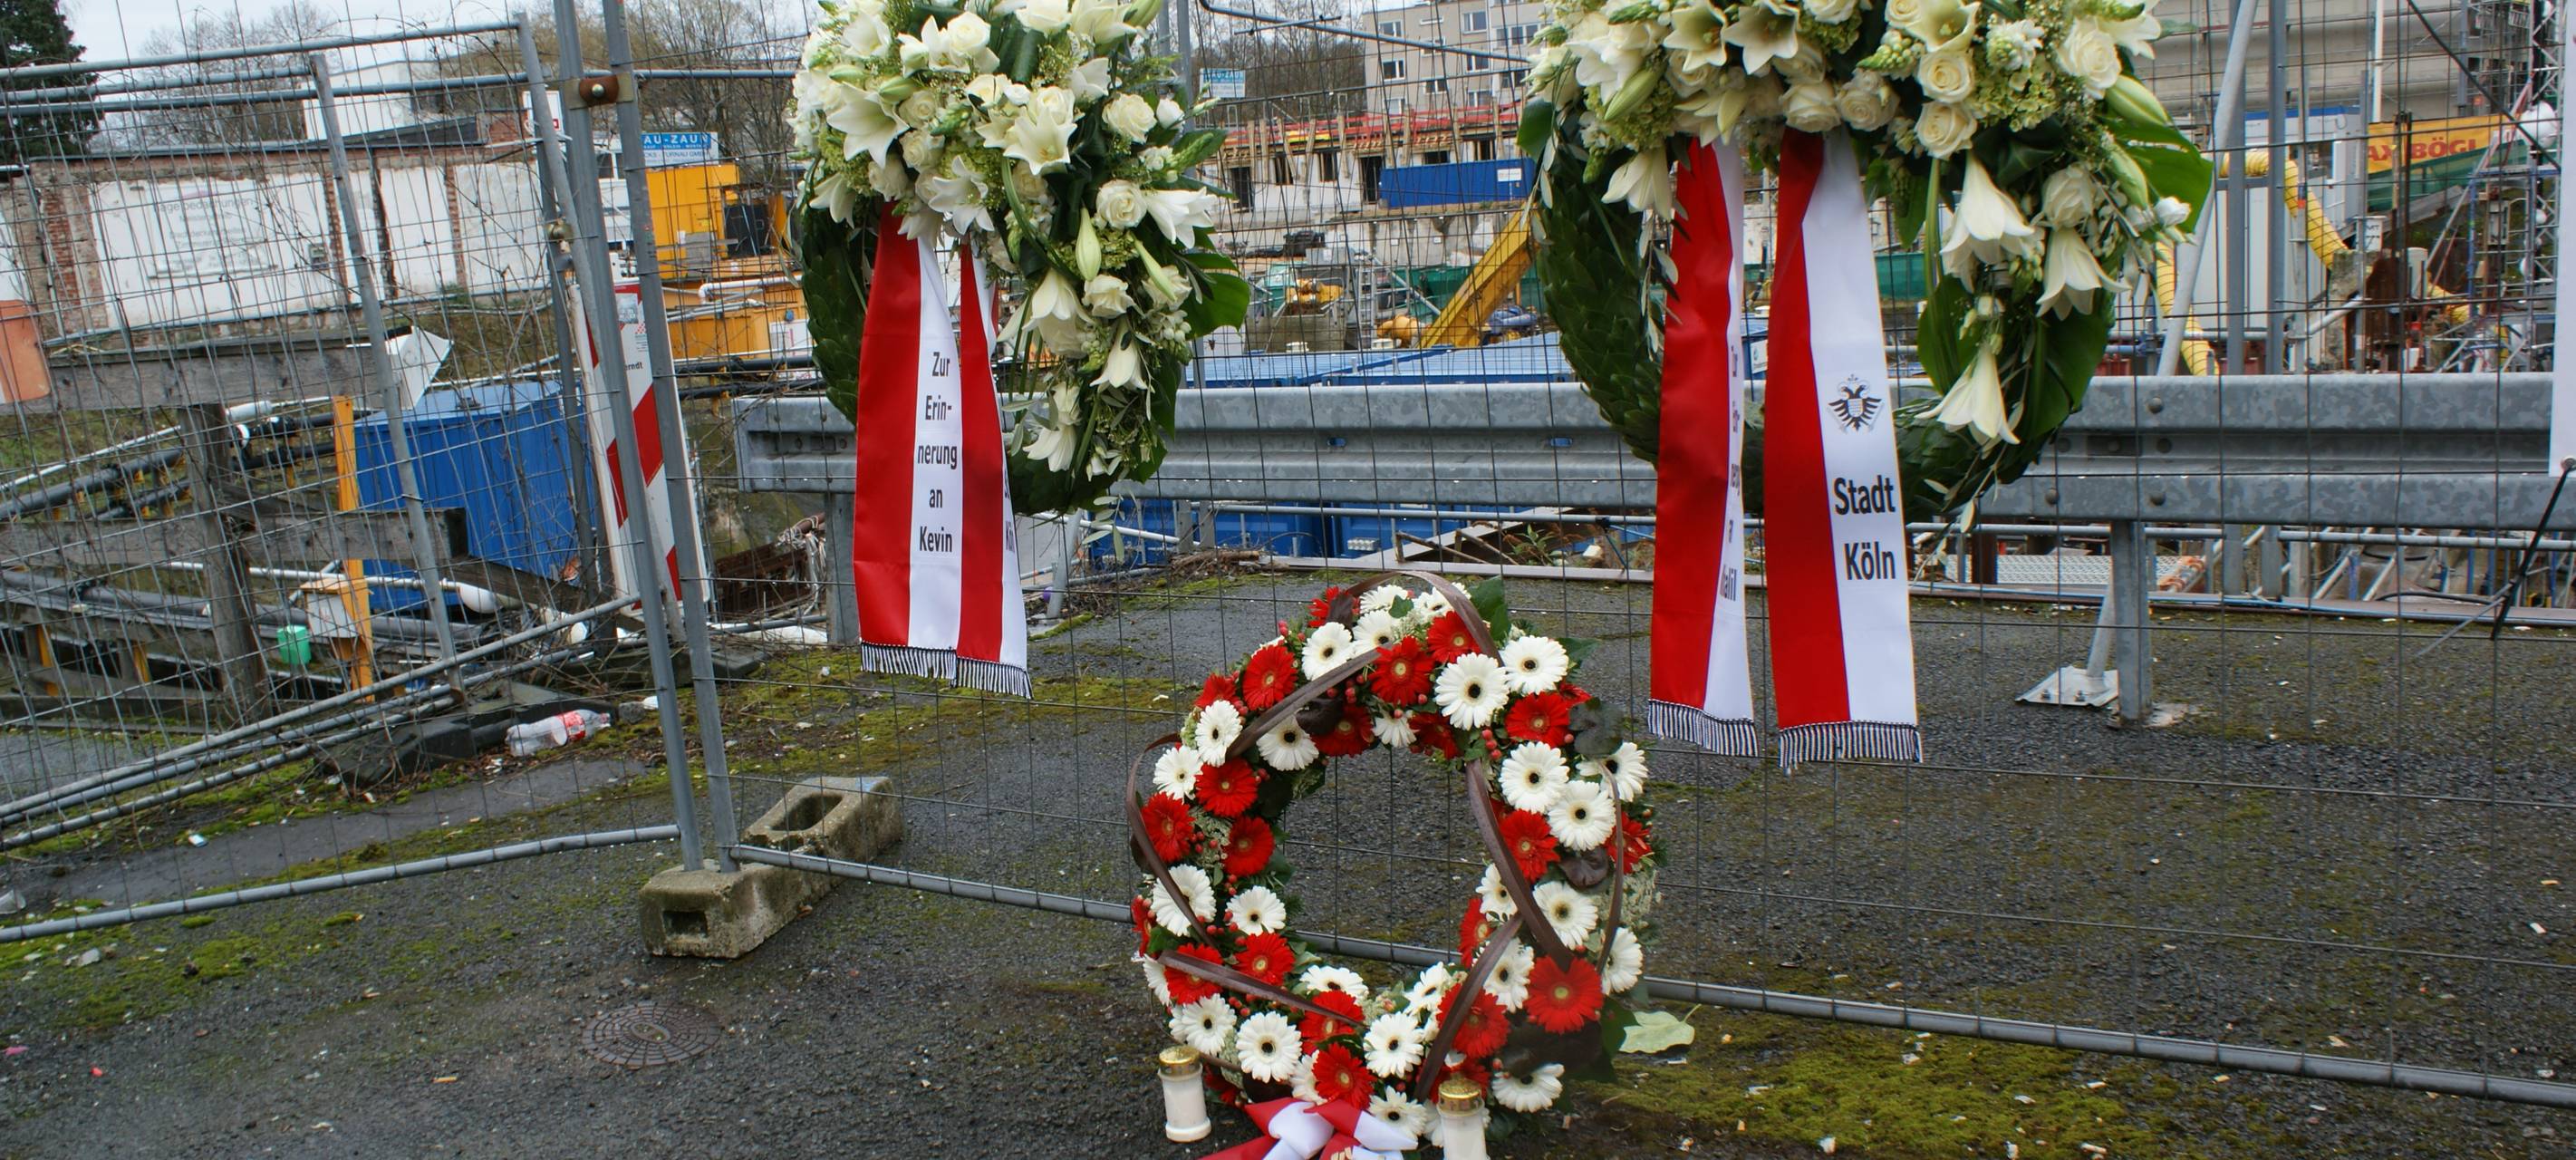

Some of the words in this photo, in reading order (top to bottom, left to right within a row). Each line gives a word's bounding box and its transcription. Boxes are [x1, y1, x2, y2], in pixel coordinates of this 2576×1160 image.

[643, 134, 709, 145] AU-ZAUN
[2368, 143, 2393, 161] AX
[623, 361, 643, 372] erndt
[931, 352, 950, 377] Zur
[925, 395, 952, 420] Erin-
[917, 444, 958, 469] nerung
[929, 488, 943, 508] an
[1834, 474, 1896, 516] Stadt
[919, 526, 953, 553] Kevin
[1844, 540, 1896, 580] Köln
